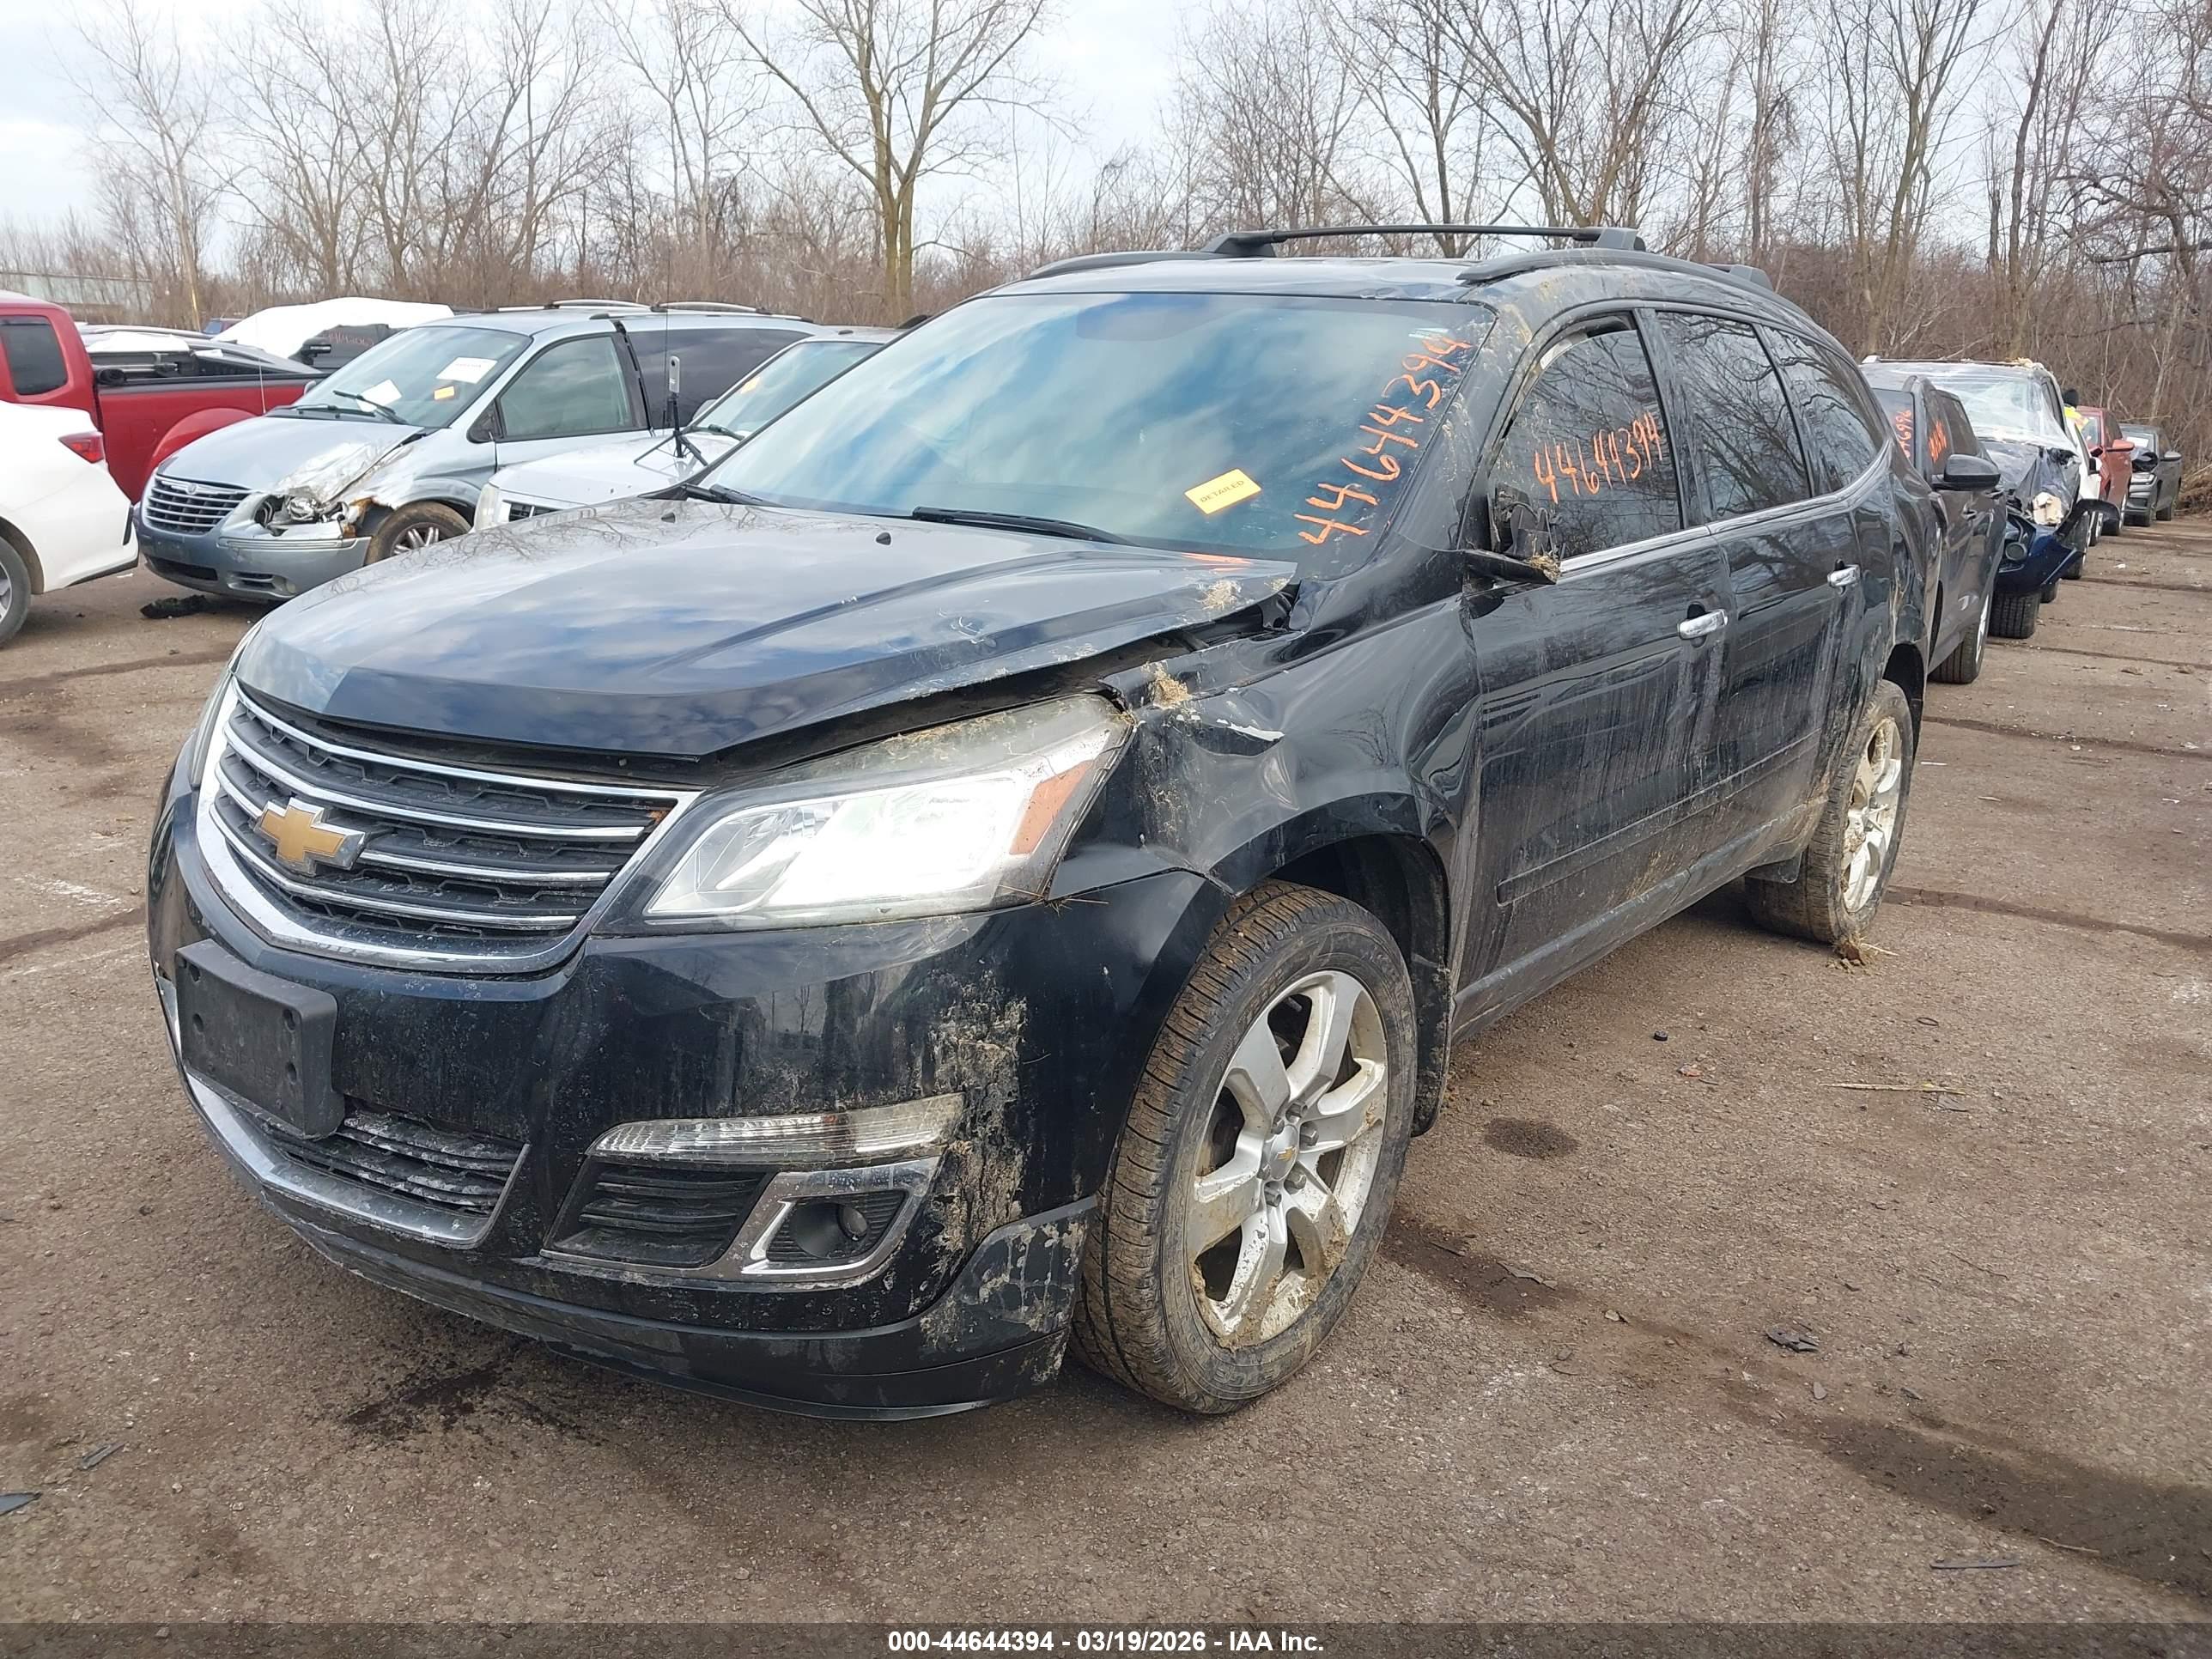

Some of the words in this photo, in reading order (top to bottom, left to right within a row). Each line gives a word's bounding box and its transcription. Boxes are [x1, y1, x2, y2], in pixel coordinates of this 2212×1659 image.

[1293, 336, 1472, 544] 44644394
[1534, 412, 1663, 505] 44644394
[1200, 480, 1244, 502] DETAILED
